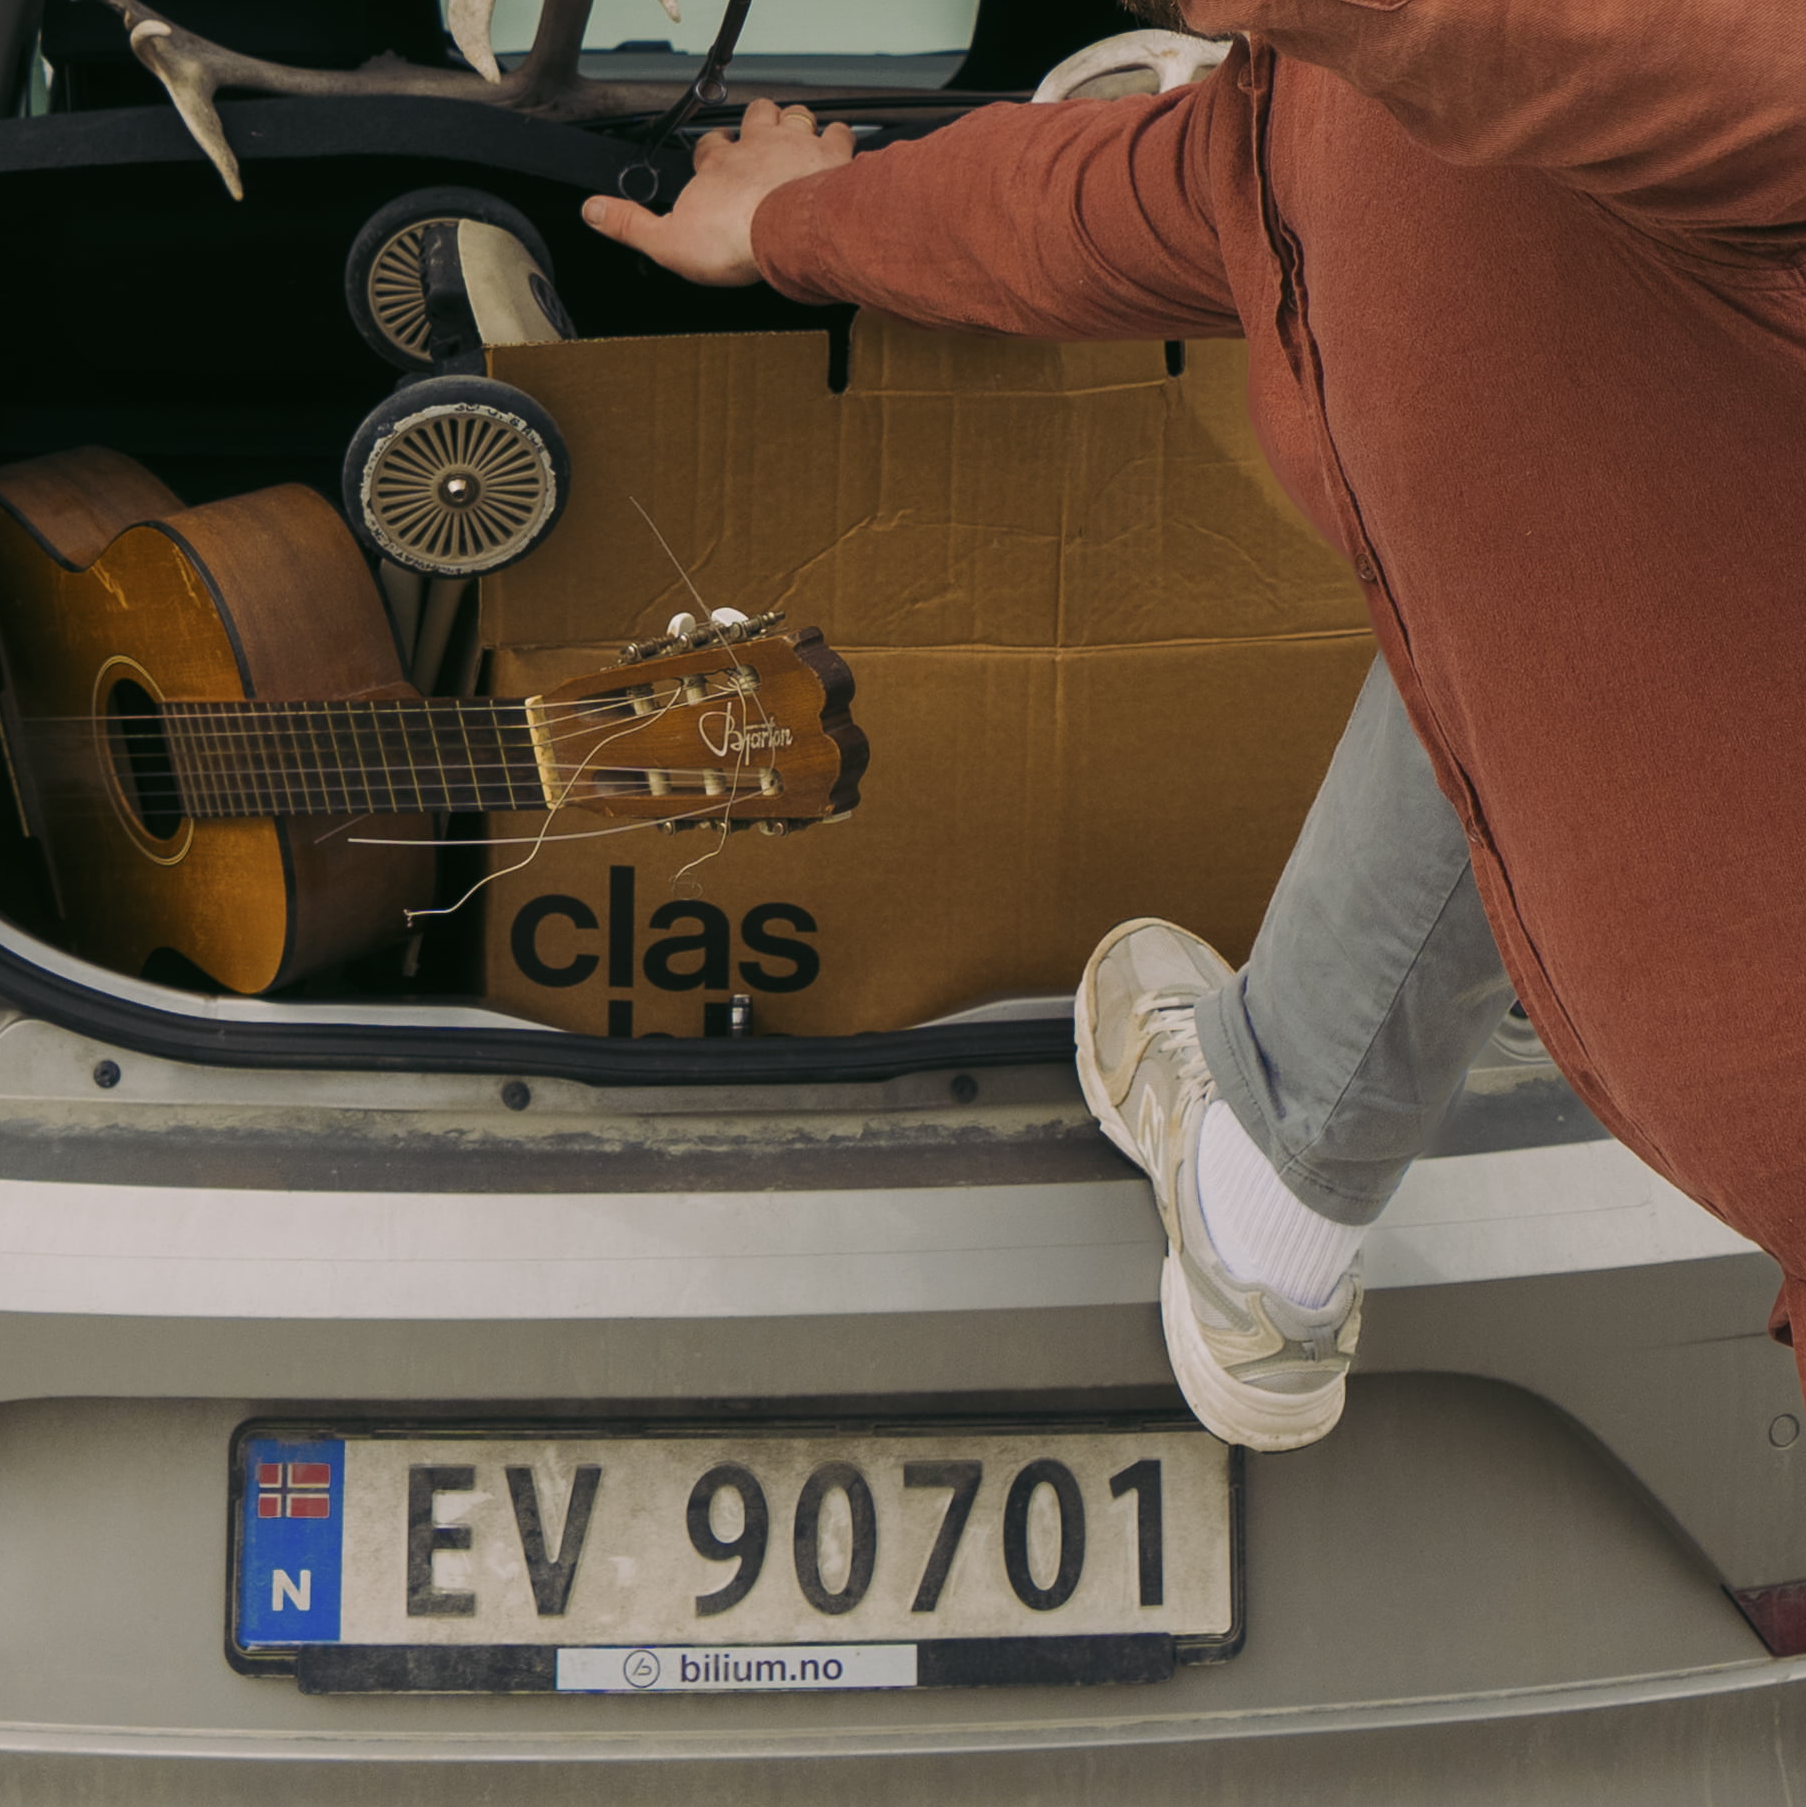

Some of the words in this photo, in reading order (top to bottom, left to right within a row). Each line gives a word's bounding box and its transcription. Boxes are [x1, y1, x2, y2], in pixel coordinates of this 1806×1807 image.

[510, 865, 820, 993] clas
[407, 1463, 602, 1618] EV
[686, 1458, 1164, 1618] 90701
[272, 1569, 311, 1611] N
[679, 1653, 843, 1683] bilium.no
